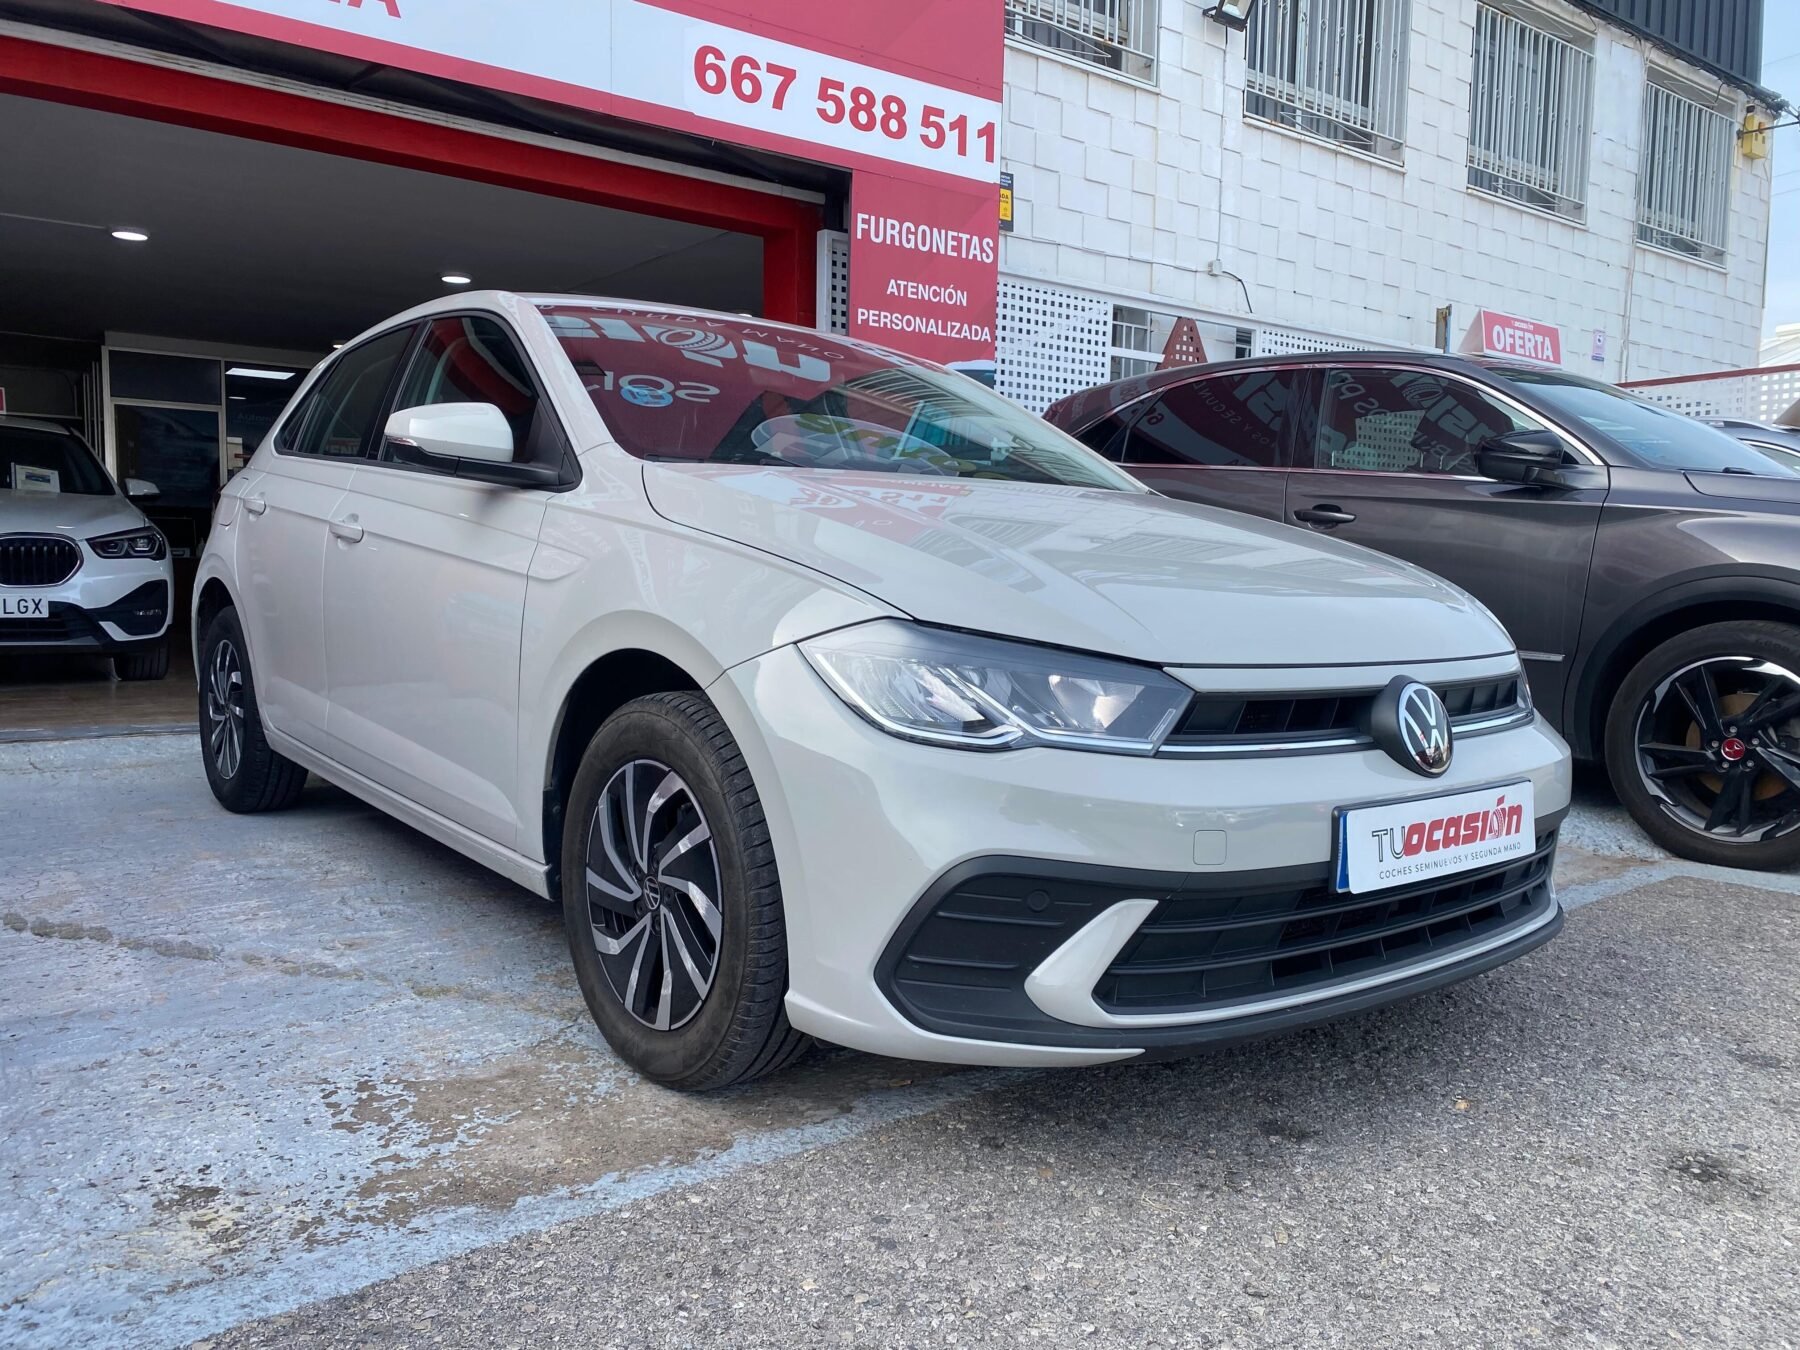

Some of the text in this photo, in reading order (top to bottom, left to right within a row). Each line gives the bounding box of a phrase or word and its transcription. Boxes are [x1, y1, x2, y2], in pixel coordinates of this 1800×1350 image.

[694, 45, 996, 163] 667 588 511
[856, 213, 994, 264] FURGONETAS
[886, 278, 968, 307] ATENCIÓN
[857, 308, 992, 343] PERSONALIZADA
[1492, 324, 1554, 361] OFERTA
[2, 598, 43, 615] LGX
[1379, 841, 1521, 880] COCHES SEMINUEVOS Y SEGUNDA MANO
